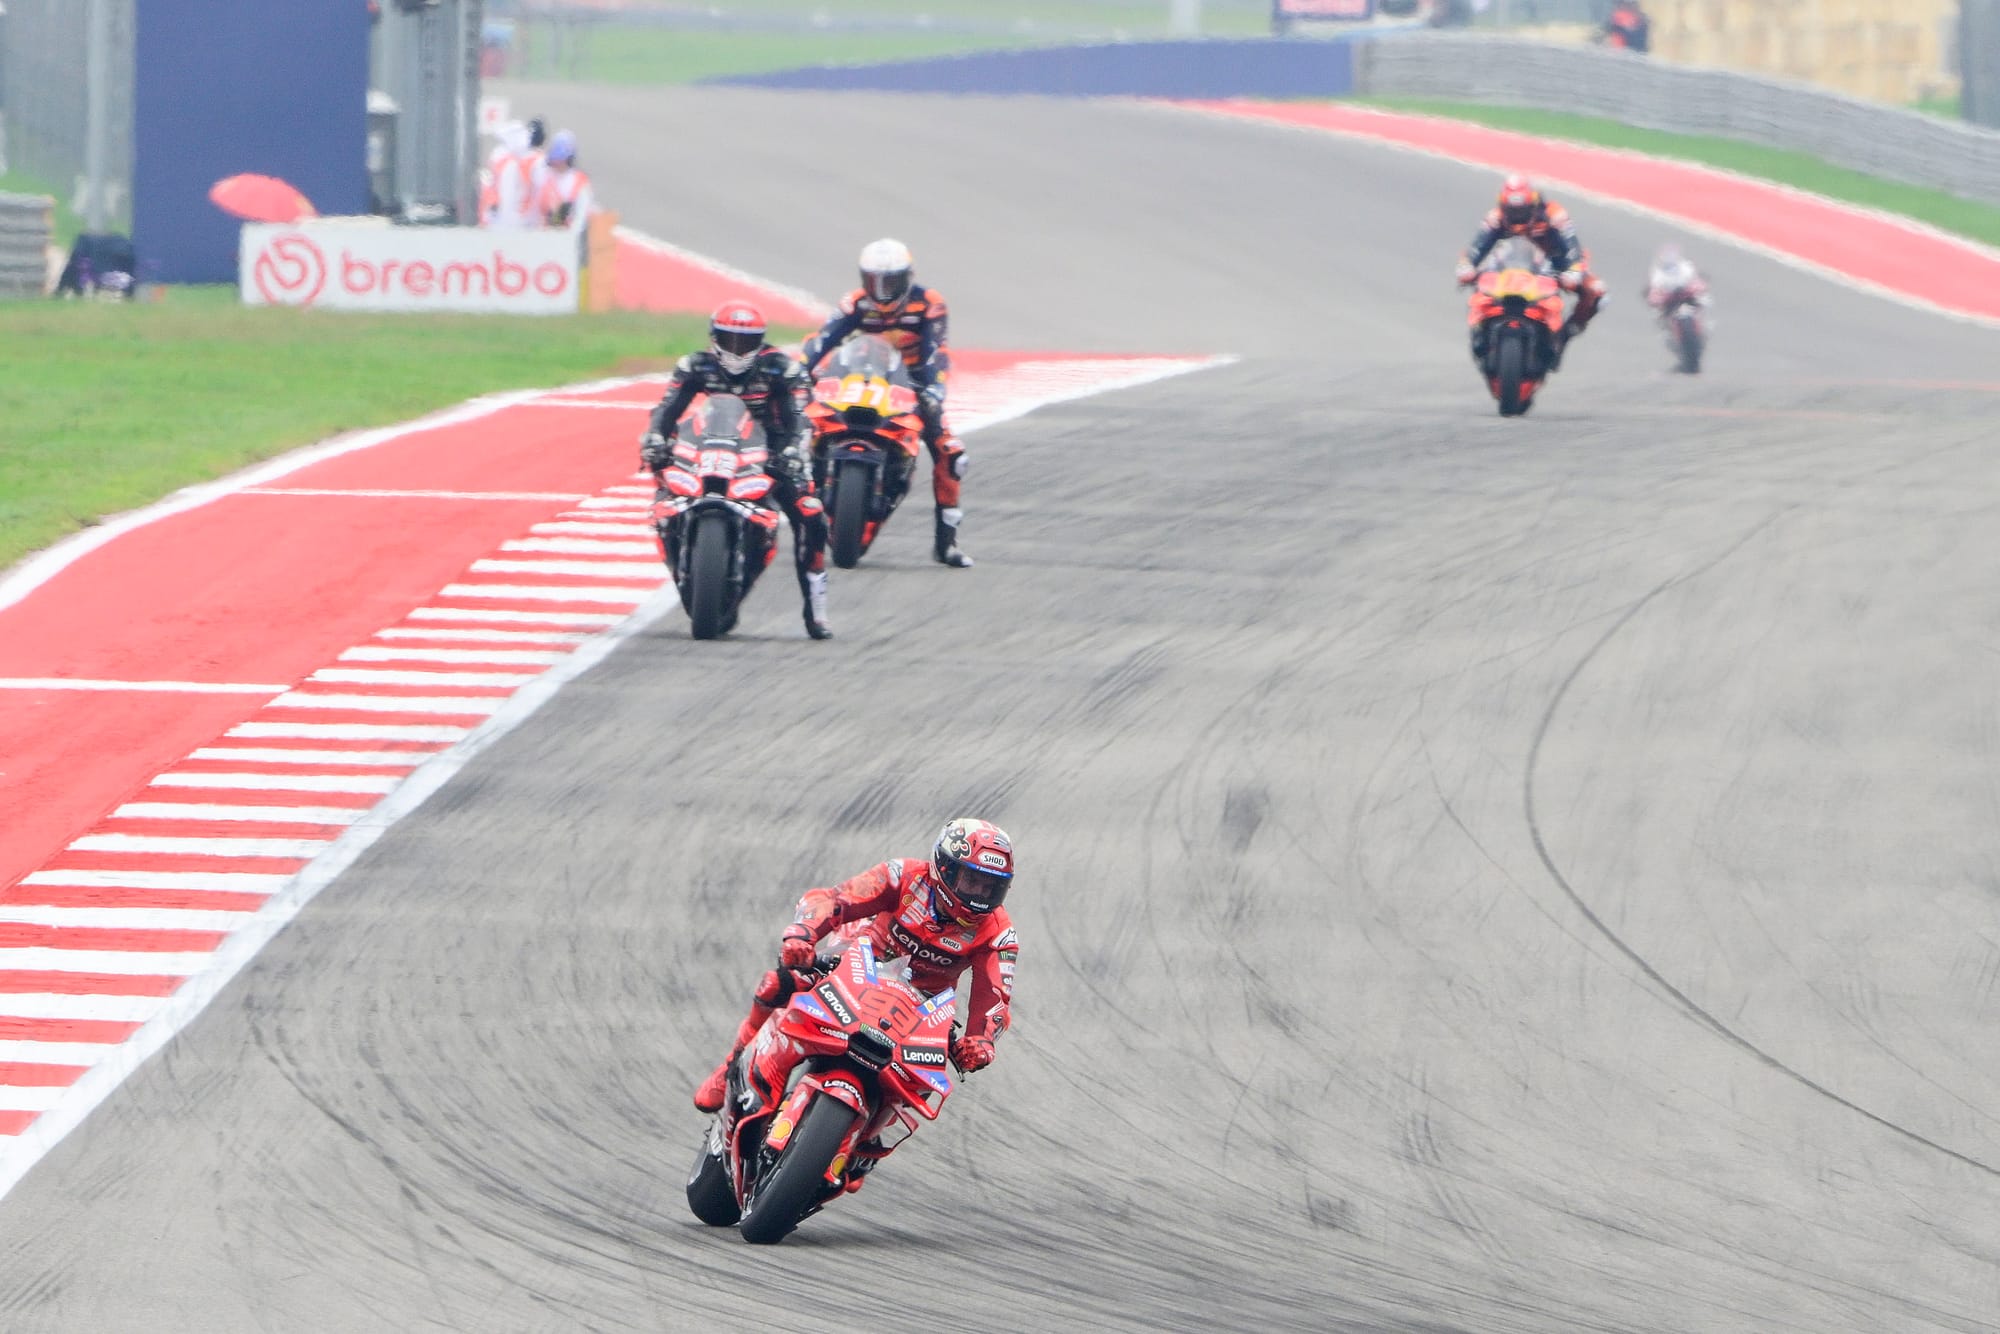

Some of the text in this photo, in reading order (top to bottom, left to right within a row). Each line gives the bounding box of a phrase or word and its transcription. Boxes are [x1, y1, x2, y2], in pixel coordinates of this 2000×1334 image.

[341, 249, 568, 297] brembo
[842, 382, 886, 406] 37
[891, 923, 953, 965] Lenovo
[819, 984, 852, 1024] Lenovo
[903, 1049, 945, 1064] Lenovo
[824, 1079, 863, 1108] Lenovo
